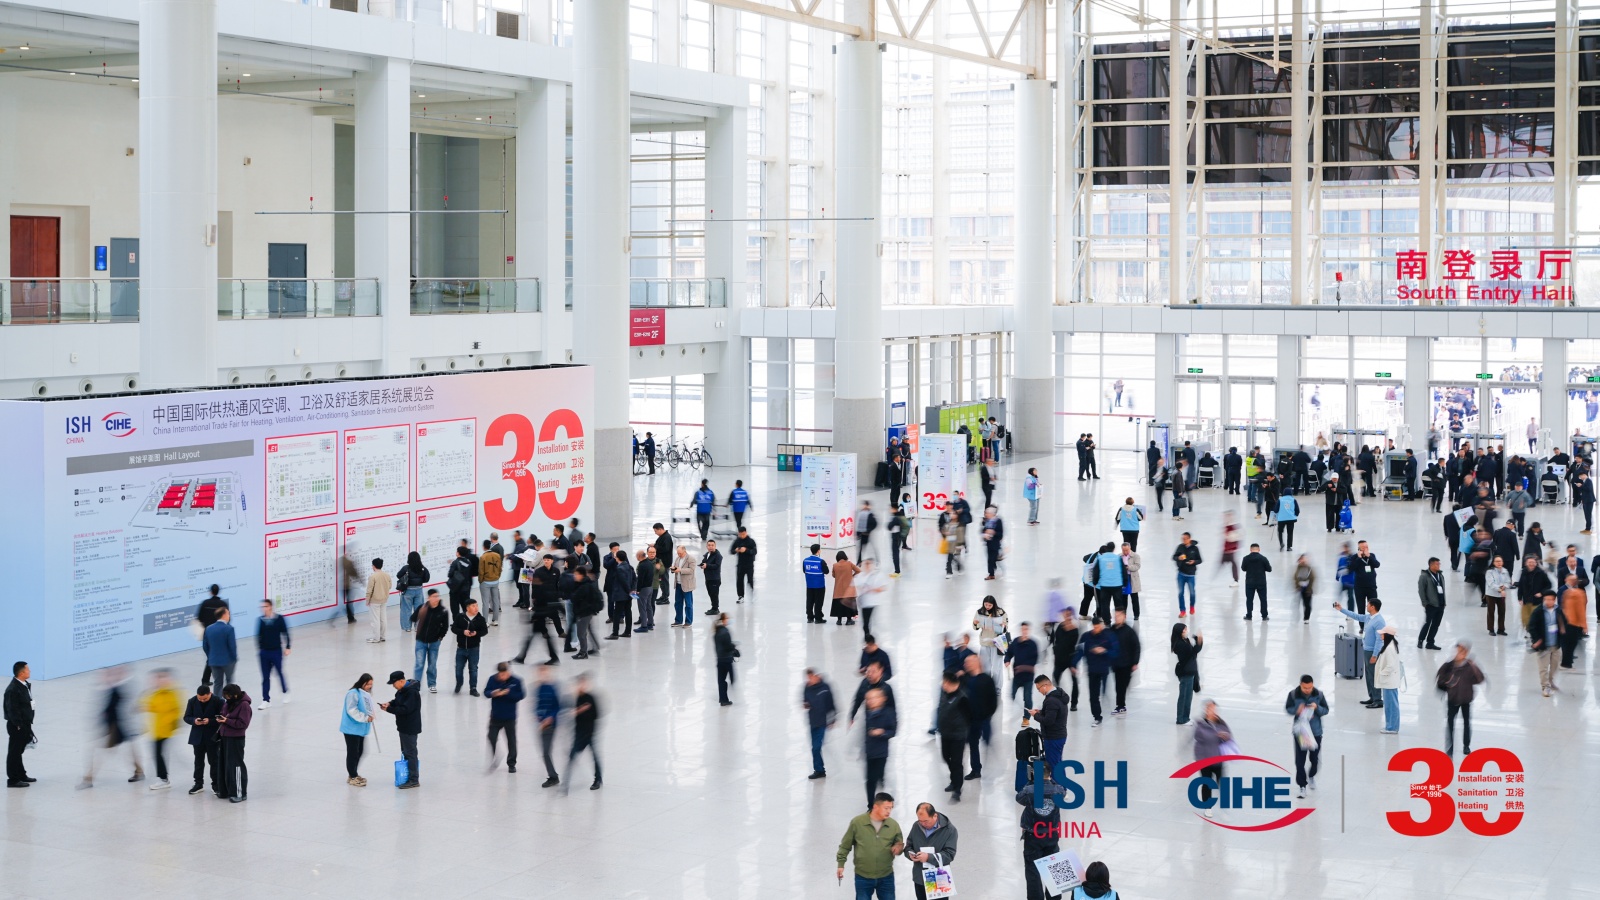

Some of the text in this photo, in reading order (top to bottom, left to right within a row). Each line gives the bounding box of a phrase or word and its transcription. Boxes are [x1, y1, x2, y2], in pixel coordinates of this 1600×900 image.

[1395, 249, 1572, 281] 南登录厅
[1396, 285, 1572, 303] South Entry Hall
[66, 415, 91, 434] ISH
[105, 418, 132, 431] CIHE
[153, 426, 171, 435] China
[172, 423, 211, 433] International
[212, 421, 228, 430] Trade
[229, 420, 240, 428] Fair
[241, 419, 249, 427] for
[275, 414, 305, 424] Ventilation,
[351, 408, 376, 417] Sanitation
[381, 406, 397, 414] Home
[417, 403, 435, 411] System
[66, 437, 85, 445] CHINA
[570, 440, 584, 451] 安装
[537, 443, 569, 455] Installation
[163, 450, 201, 461] Hall Layout
[502, 461, 516, 470] Since
[537, 461, 566, 473] Sanitation
[570, 457, 584, 468] 卫浴
[483, 408, 584, 531] 30
[514, 469, 526, 477] 1996
[537, 478, 560, 489] Heating
[570, 473, 584, 485] 供热
[922, 492, 948, 511] 30
